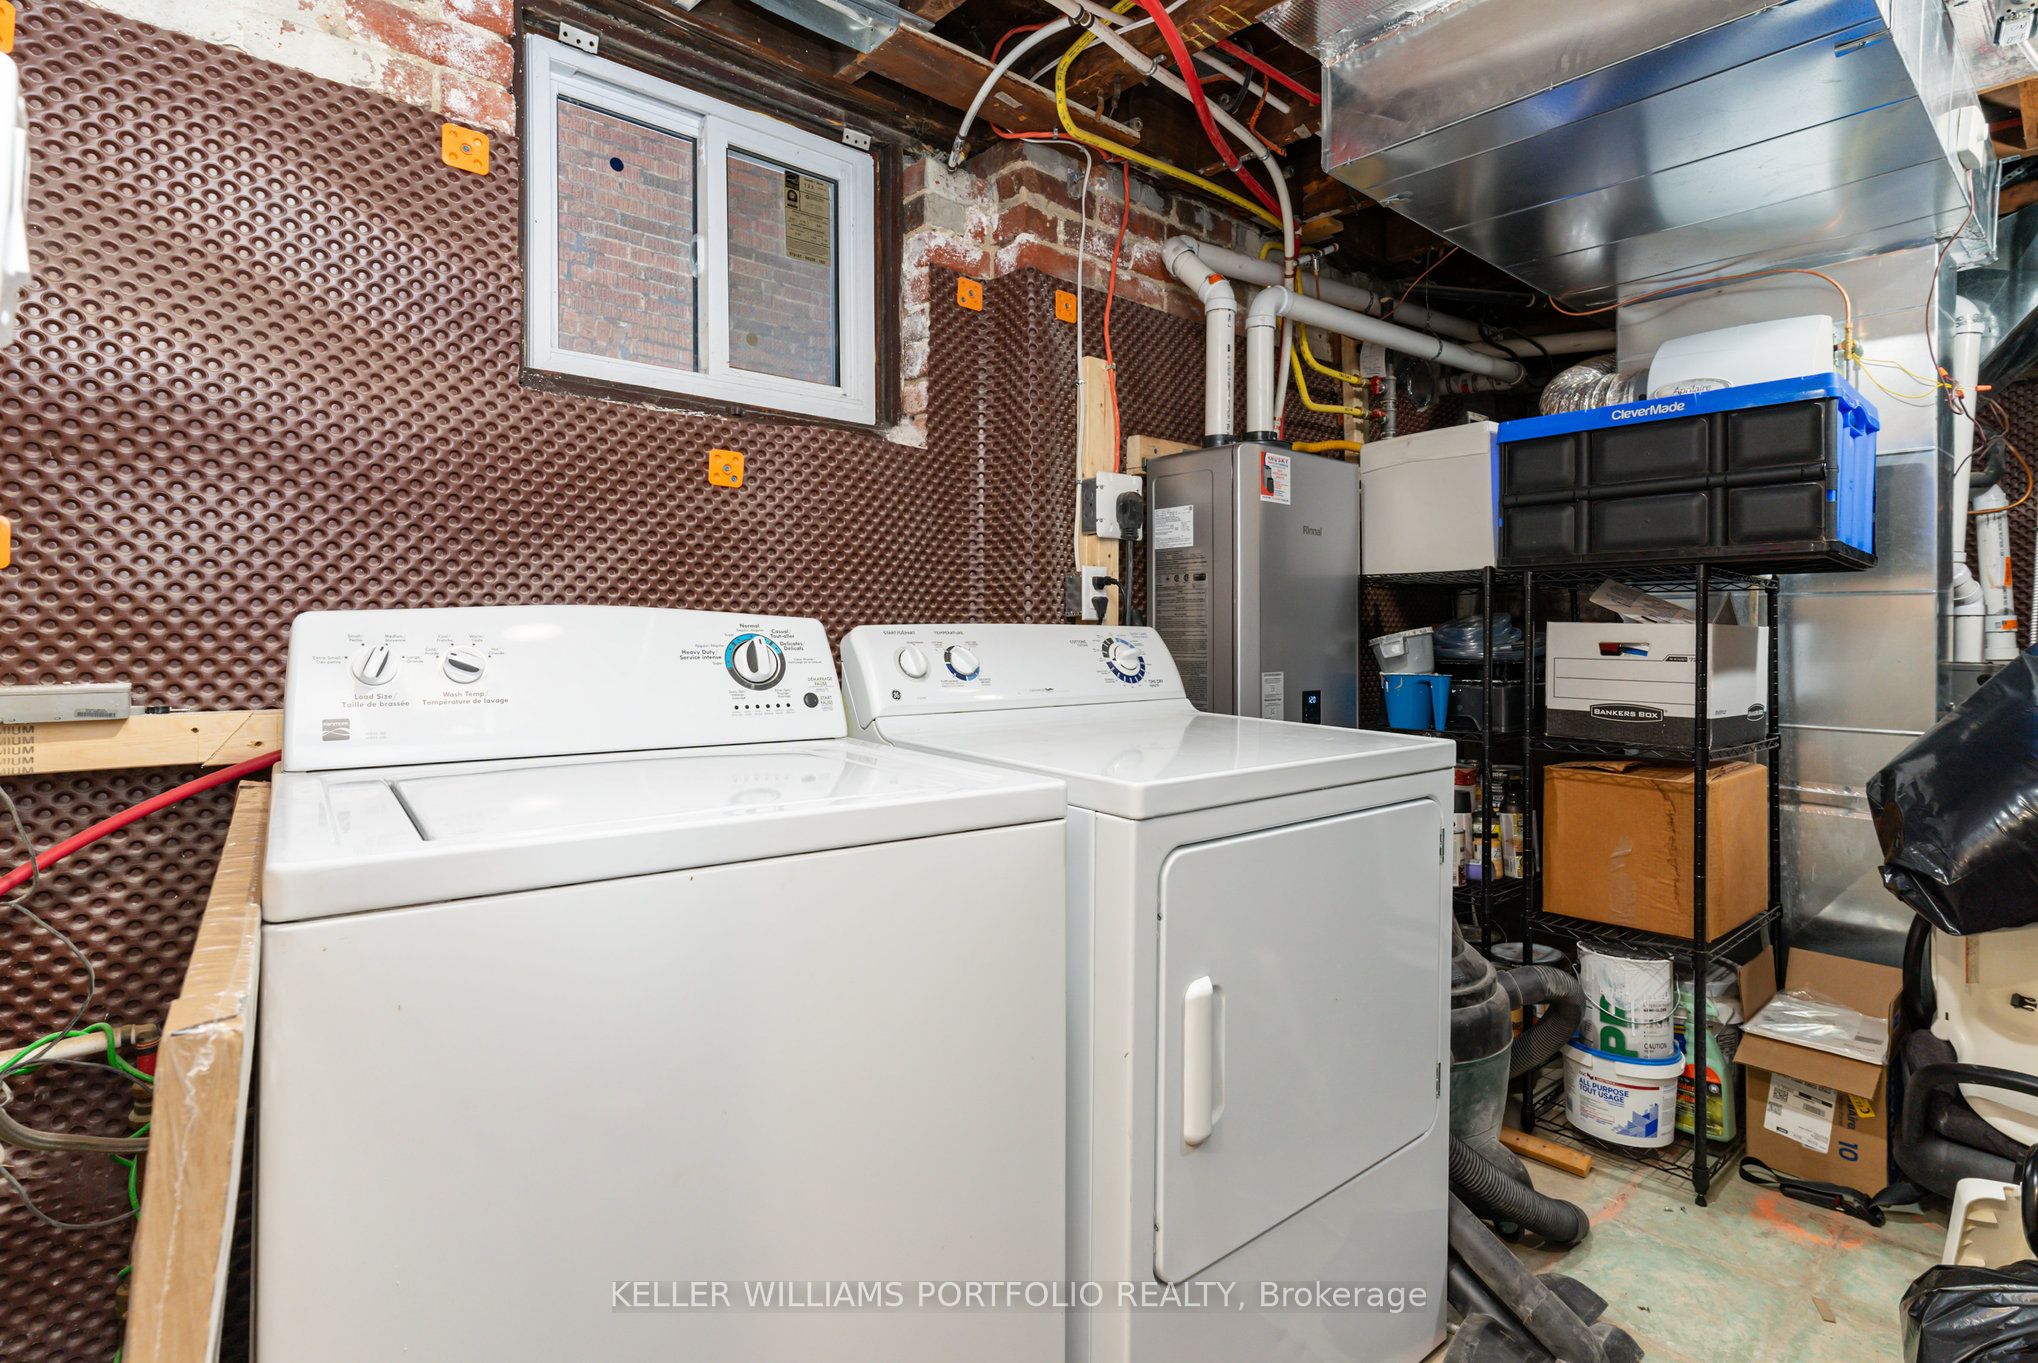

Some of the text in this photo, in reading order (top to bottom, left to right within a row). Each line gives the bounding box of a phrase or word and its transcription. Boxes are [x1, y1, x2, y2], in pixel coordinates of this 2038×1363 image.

[1611, 401, 1685, 421] CleverMade
[1302, 525, 1323, 537] Rinnai
[366, 700, 377, 708] de
[1593, 708, 1659, 719] BANKERS BOX
[1579, 1077, 1591, 1089] ALL
[1592, 1082, 1629, 1098] PURPOSE
[1579, 1084, 1625, 1104] TOUT USAGE
[1838, 1141, 1859, 1162] 10
